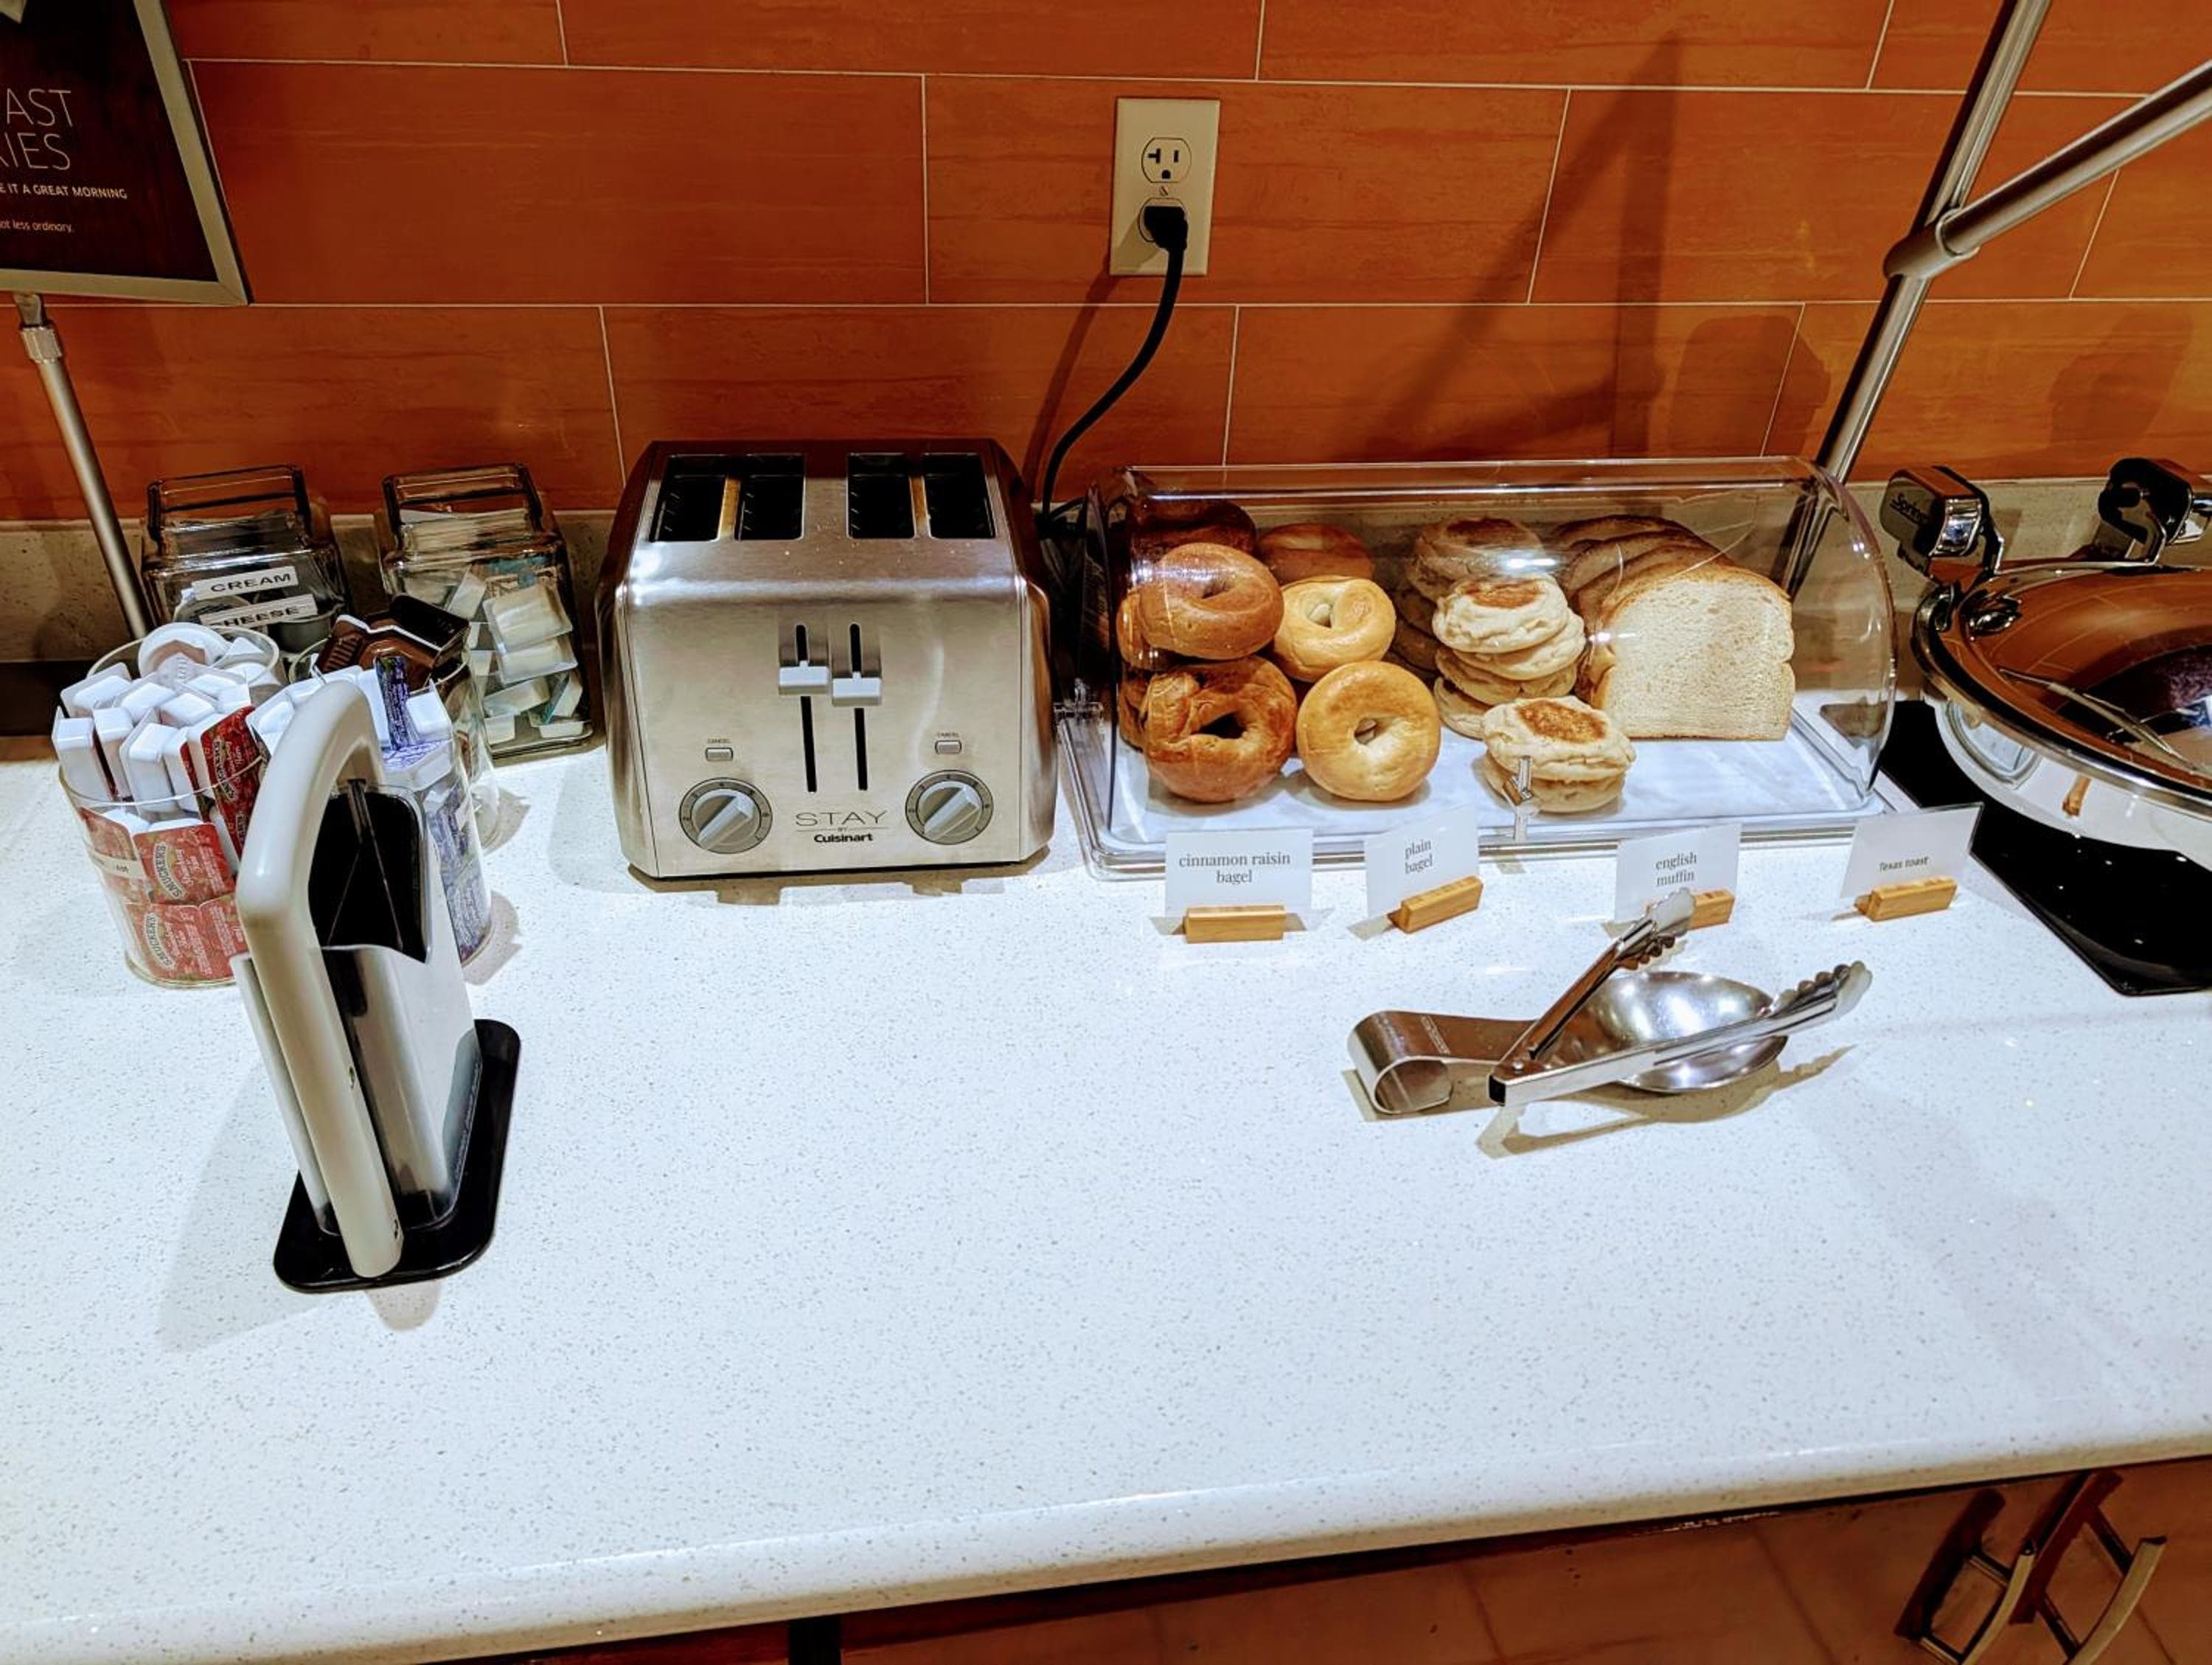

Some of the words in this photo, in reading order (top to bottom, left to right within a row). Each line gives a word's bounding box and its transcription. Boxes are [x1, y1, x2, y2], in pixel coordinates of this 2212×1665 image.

[6, 88, 73, 128] AST
[8, 183, 18, 194] IT
[23, 184, 31, 194] A
[33, 184, 69, 196] GREAT
[72, 187, 128, 200] MORNING
[211, 573, 291, 592] CREAM
[210, 605, 299, 627] HEESE
[796, 810, 888, 827] STAY
[813, 833, 873, 843] Cuisinart
[1405, 839, 1432, 860] plain
[1179, 853, 1248, 867] cinnamon
[1252, 851, 1291, 866] raisin
[1405, 853, 1433, 874] bagel
[1655, 852, 1697, 870] english
[1905, 855, 1929, 868] toast
[1217, 869, 1253, 886] bagel
[1657, 869, 1695, 886] muffin
